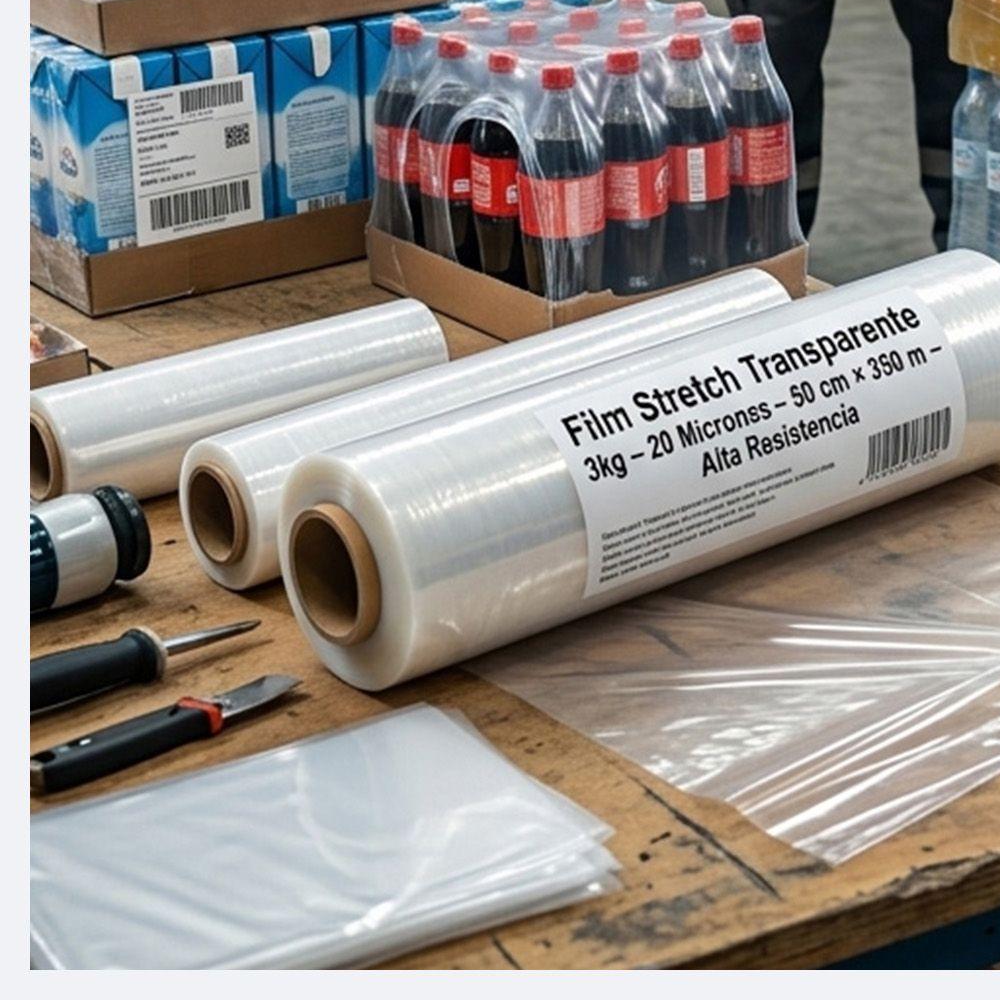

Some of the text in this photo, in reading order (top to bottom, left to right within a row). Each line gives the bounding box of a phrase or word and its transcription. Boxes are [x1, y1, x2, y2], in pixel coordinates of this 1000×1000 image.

[560, 305, 922, 448] Film Stretch Transparente
[583, 452, 629, 483] 3kg
[646, 428, 675, 461] 20
[675, 400, 774, 449] Micronss
[788, 380, 816, 409] 50
[818, 373, 852, 399] cm
[866, 349, 906, 382] 350
[905, 346, 928, 368] m
[701, 402, 862, 479] Alta Resistencia
